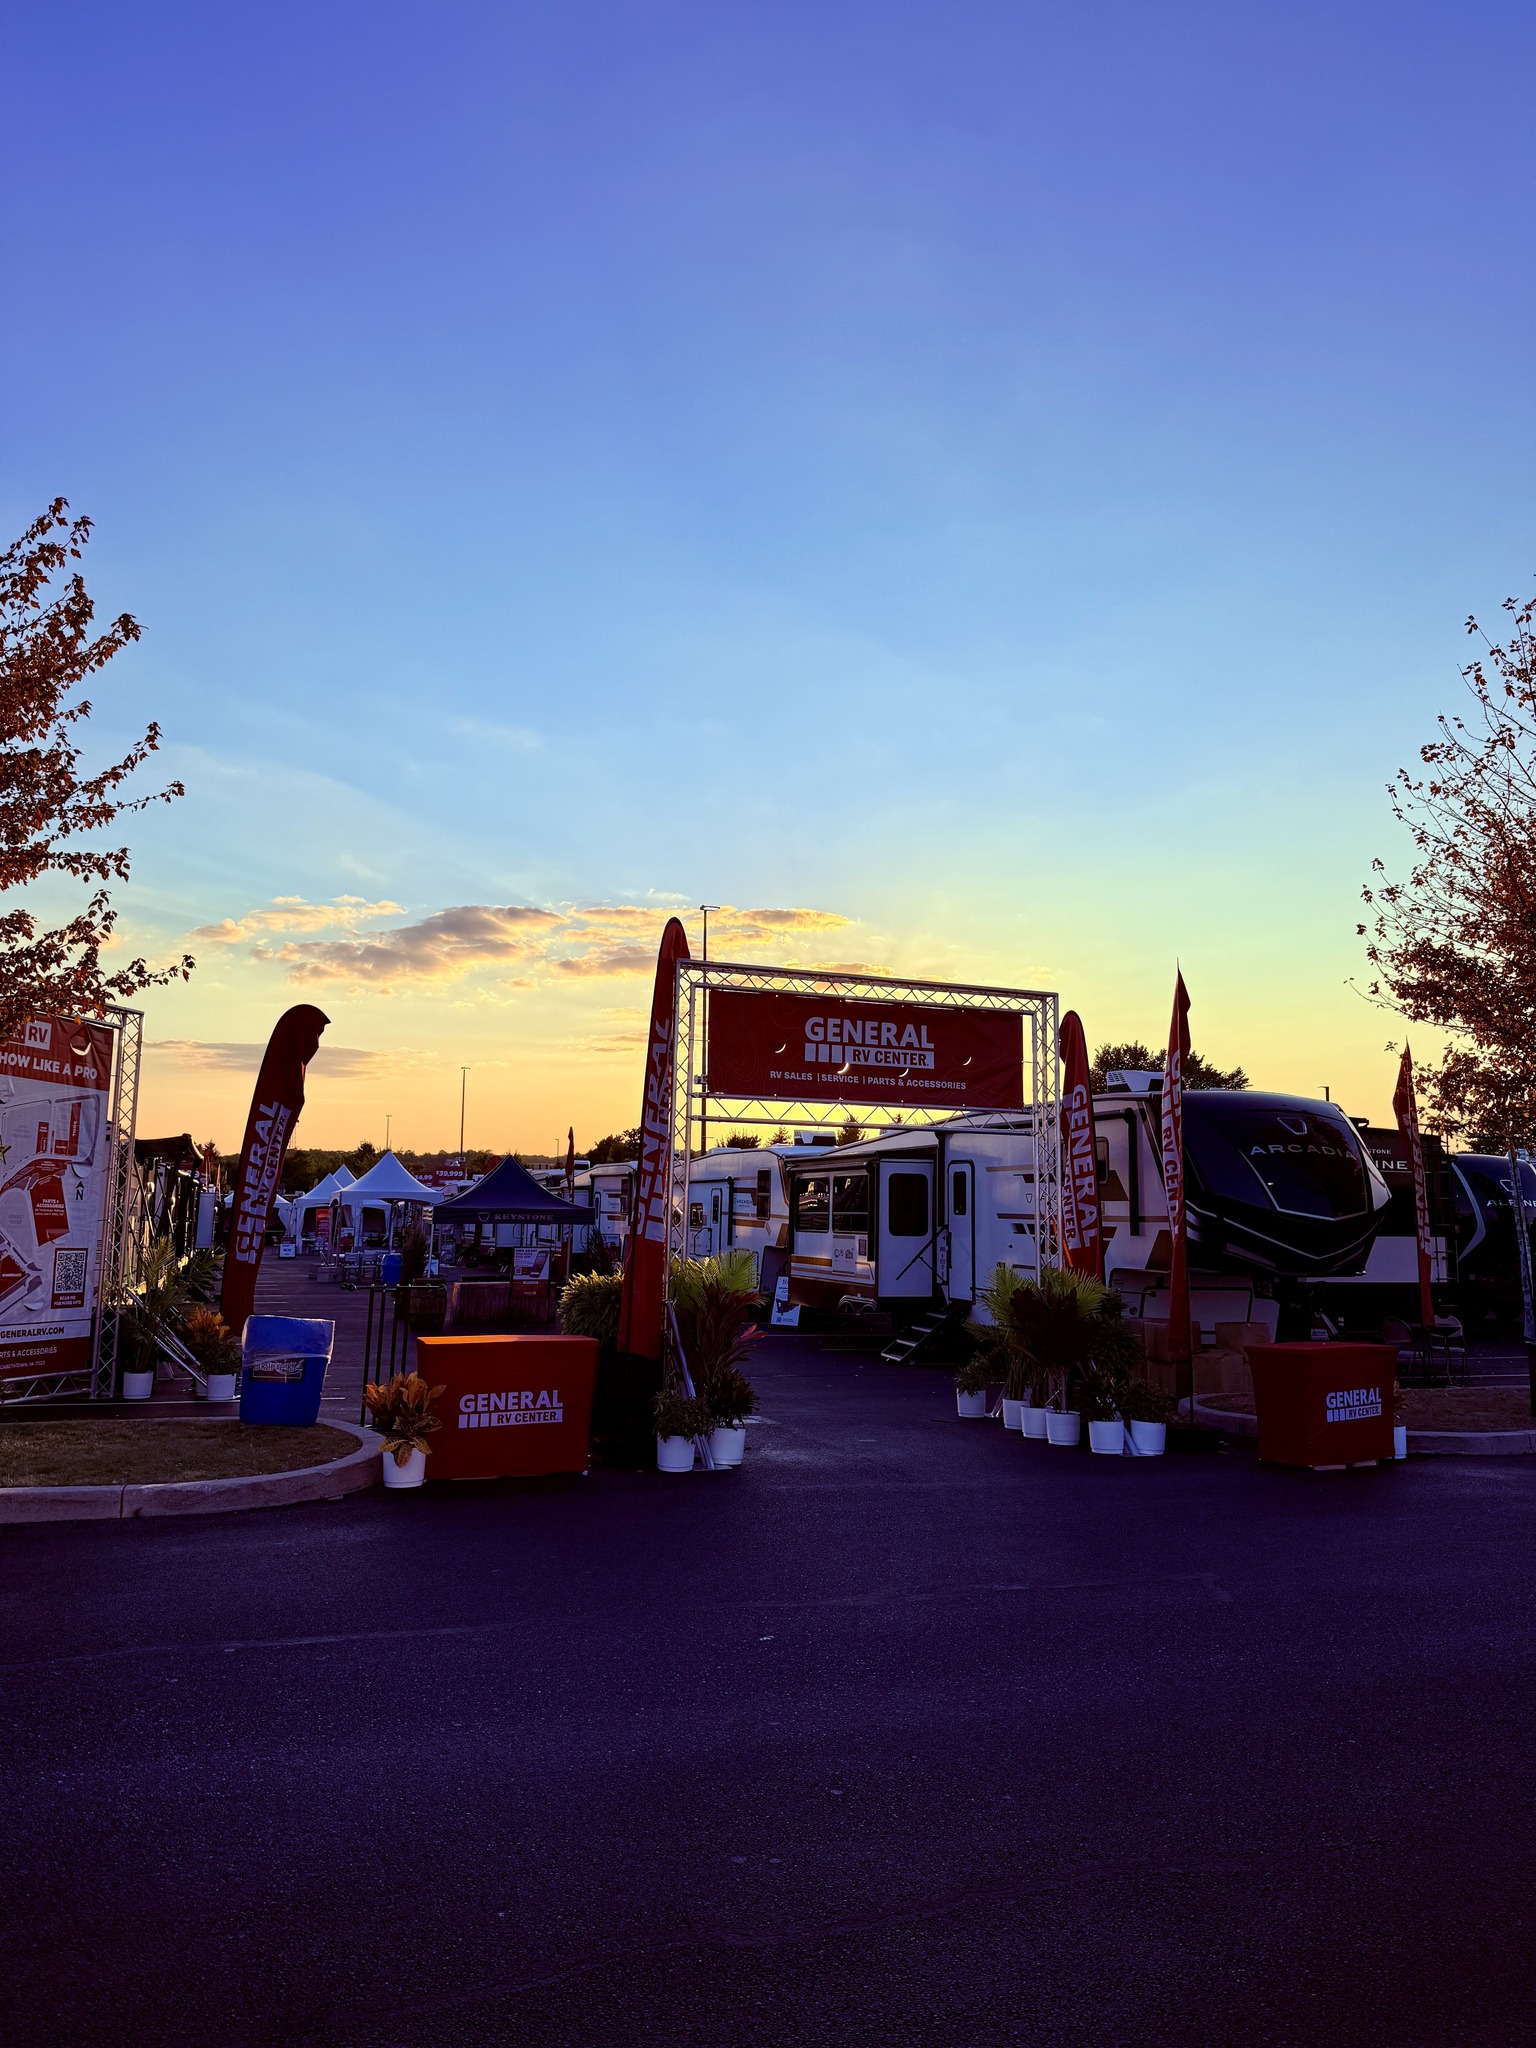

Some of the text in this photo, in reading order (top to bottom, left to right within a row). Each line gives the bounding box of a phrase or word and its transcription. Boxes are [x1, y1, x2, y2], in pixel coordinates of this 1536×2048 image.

[28, 1026, 48, 1042] RV
[805, 1016, 934, 1049] GENERAL
[0, 1051, 98, 1080] HOW LIKE A PRO
[852, 1049, 927, 1066] RV CENTER
[770, 1070, 967, 1090] RV SALES SERVICE PARTS & ACCESSORIES
[1163, 1126, 1174, 1153] RV
[1250, 1143, 1358, 1161] ARCADIA
[250, 1115, 288, 1209] RV CENTER
[1071, 1083, 1098, 1248] GENERAL
[1375, 1160, 1408, 1170] INE
[235, 1100, 280, 1263] GENERAL
[1412, 1114, 1427, 1249] ENERA
[75, 1189, 84, 1200] N
[1486, 1199, 1536, 1207] ALPNE
[494, 1213, 554, 1221] KEYSTONE
[0, 1326, 65, 1339] GENERALRV.COM
[0, 1350, 11, 1358] RTS
[17, 1346, 58, 1357] ACCESSORIES
[459, 1389, 564, 1413] GENERAL
[1326, 1387, 1382, 1409] GENERAL
[497, 1411, 557, 1424] RV CENTER
[1348, 1405, 1379, 1417] RV CENTER
